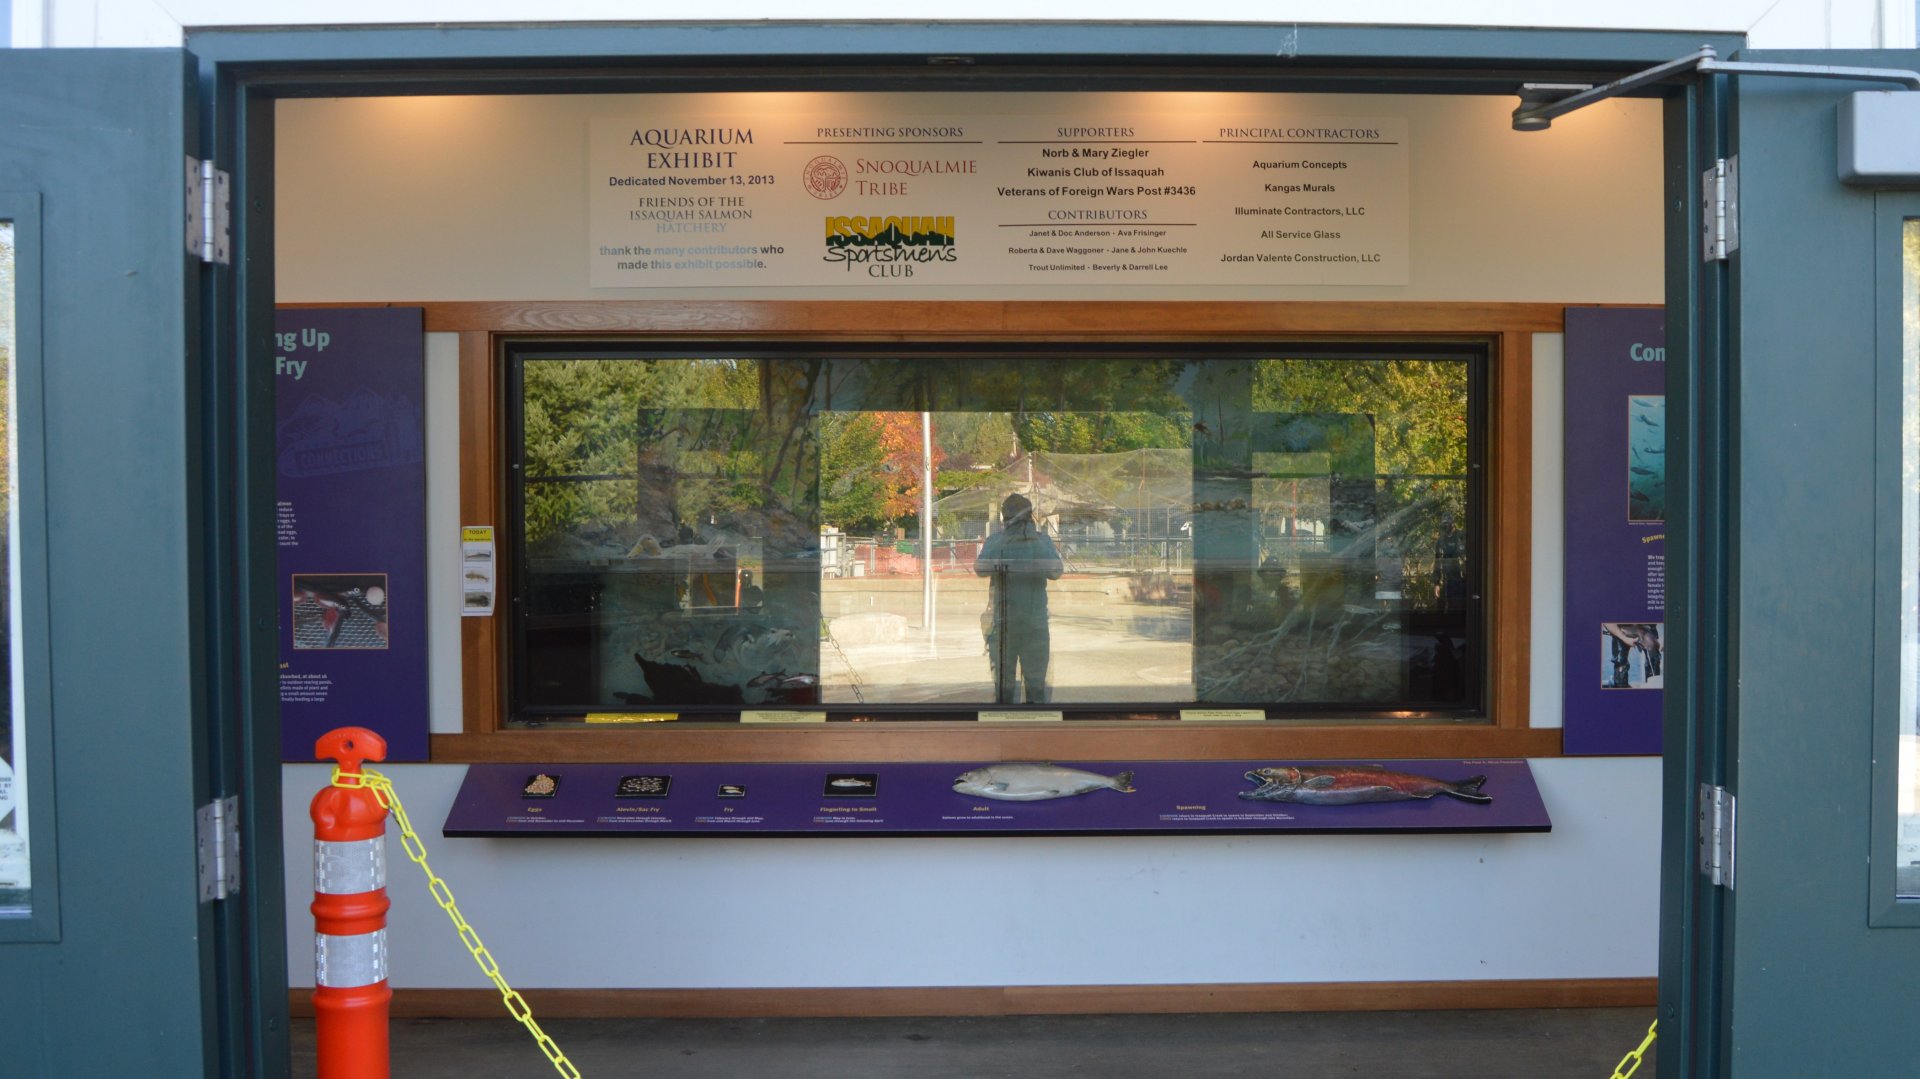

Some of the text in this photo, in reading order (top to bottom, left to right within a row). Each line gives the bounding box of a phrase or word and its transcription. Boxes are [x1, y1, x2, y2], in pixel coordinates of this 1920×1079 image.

[818, 128, 963, 137] PRESENTING SPONSORS
[1058, 128, 1134, 137] SUPPORTERS
[1220, 128, 1379, 138] PRINCIPAL CONTRACTORS
[630, 129, 753, 149] AQUARIUM
[1043, 148, 1149, 159] Norb & Mary Ziegler
[647, 152, 738, 168] EXHIBIT
[1253, 160, 1347, 170] Aquarium Concepts
[856, 158, 977, 174] SNOQUALMIE
[1028, 167, 1164, 178] Kiwanis Club of Issaquah
[609, 175, 775, 186] Dedicated November 13, 2013
[856, 181, 908, 196] TRIBE
[997, 186, 1195, 198] Veterans of Foreign Wars Post #3436
[1265, 184, 1335, 194] Kangas Murals
[639, 197, 745, 208] FRIENDS OF THE
[630, 209, 753, 222] ISSAQUAH SALMON
[1048, 210, 1147, 220] CONTRIBUTORS
[1235, 207, 1364, 216] Illuminate Contractors, LLC
[656, 222, 728, 234] HATCHERY
[826, 215, 955, 247] ISSAQUAH
[1134, 230, 1166, 238] Frisinger
[1261, 230, 1341, 239] All Service Glass
[600, 245, 784, 257] thank the many contributors who
[1066, 247, 1104, 255] Waggoner
[823, 244, 958, 272] Sportsmen's
[1221, 254, 1380, 263] Jordan Valente Construction, LLC
[617, 259, 767, 271] made this exhibit possible.
[1093, 264, 1120, 272] Beverly
[868, 264, 914, 278] CLUB
[302, 328, 330, 352] Up
[276, 356, 308, 380] Fry
